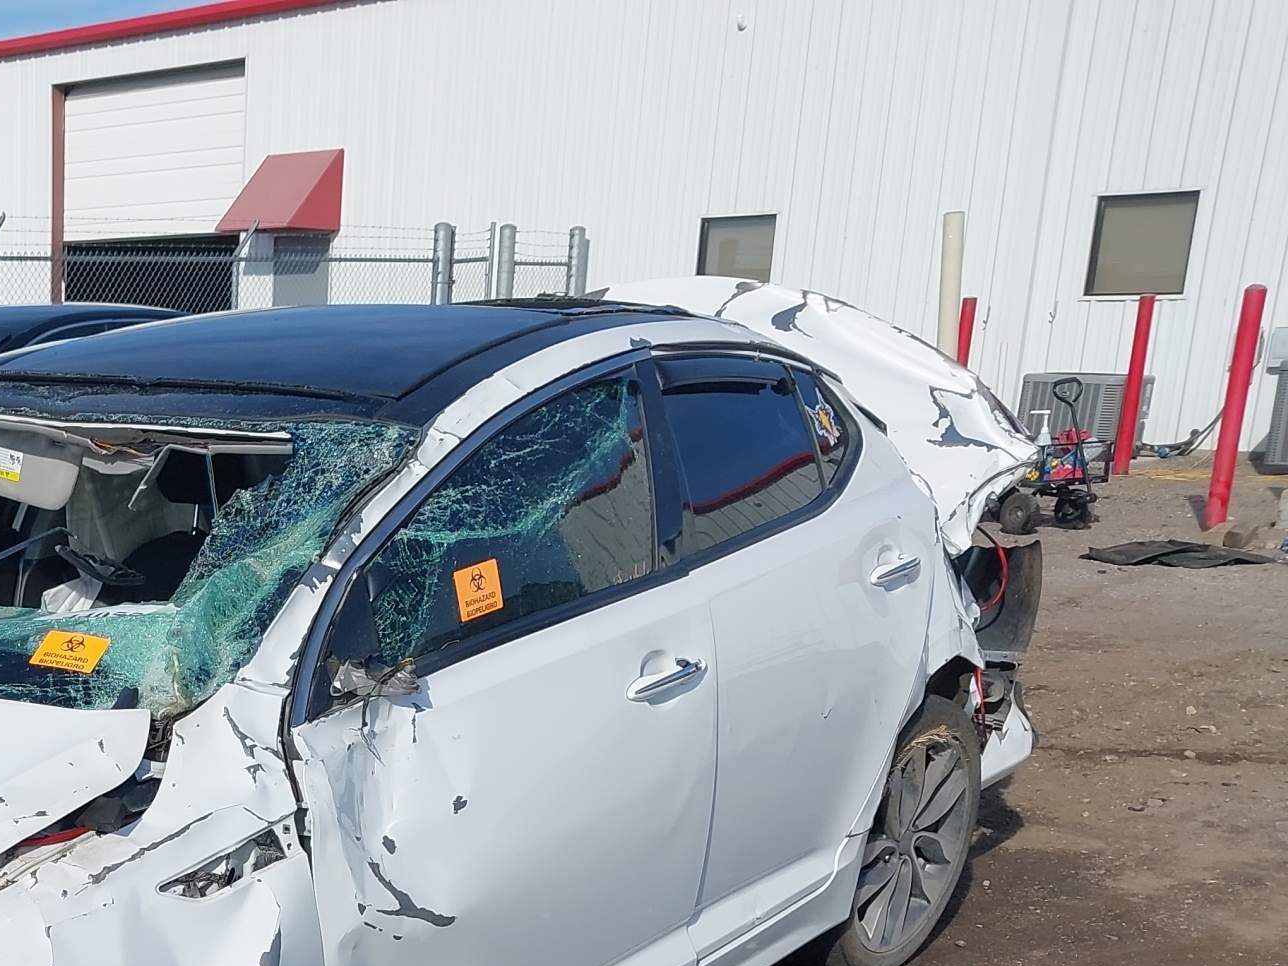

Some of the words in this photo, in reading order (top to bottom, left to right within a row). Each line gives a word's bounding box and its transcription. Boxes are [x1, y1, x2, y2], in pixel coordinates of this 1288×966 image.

[465, 591, 496, 608] BIOHAZARD
[38, 658, 85, 670] BIOPELIGRO
[43, 651, 89, 664] BIOHAZARD
